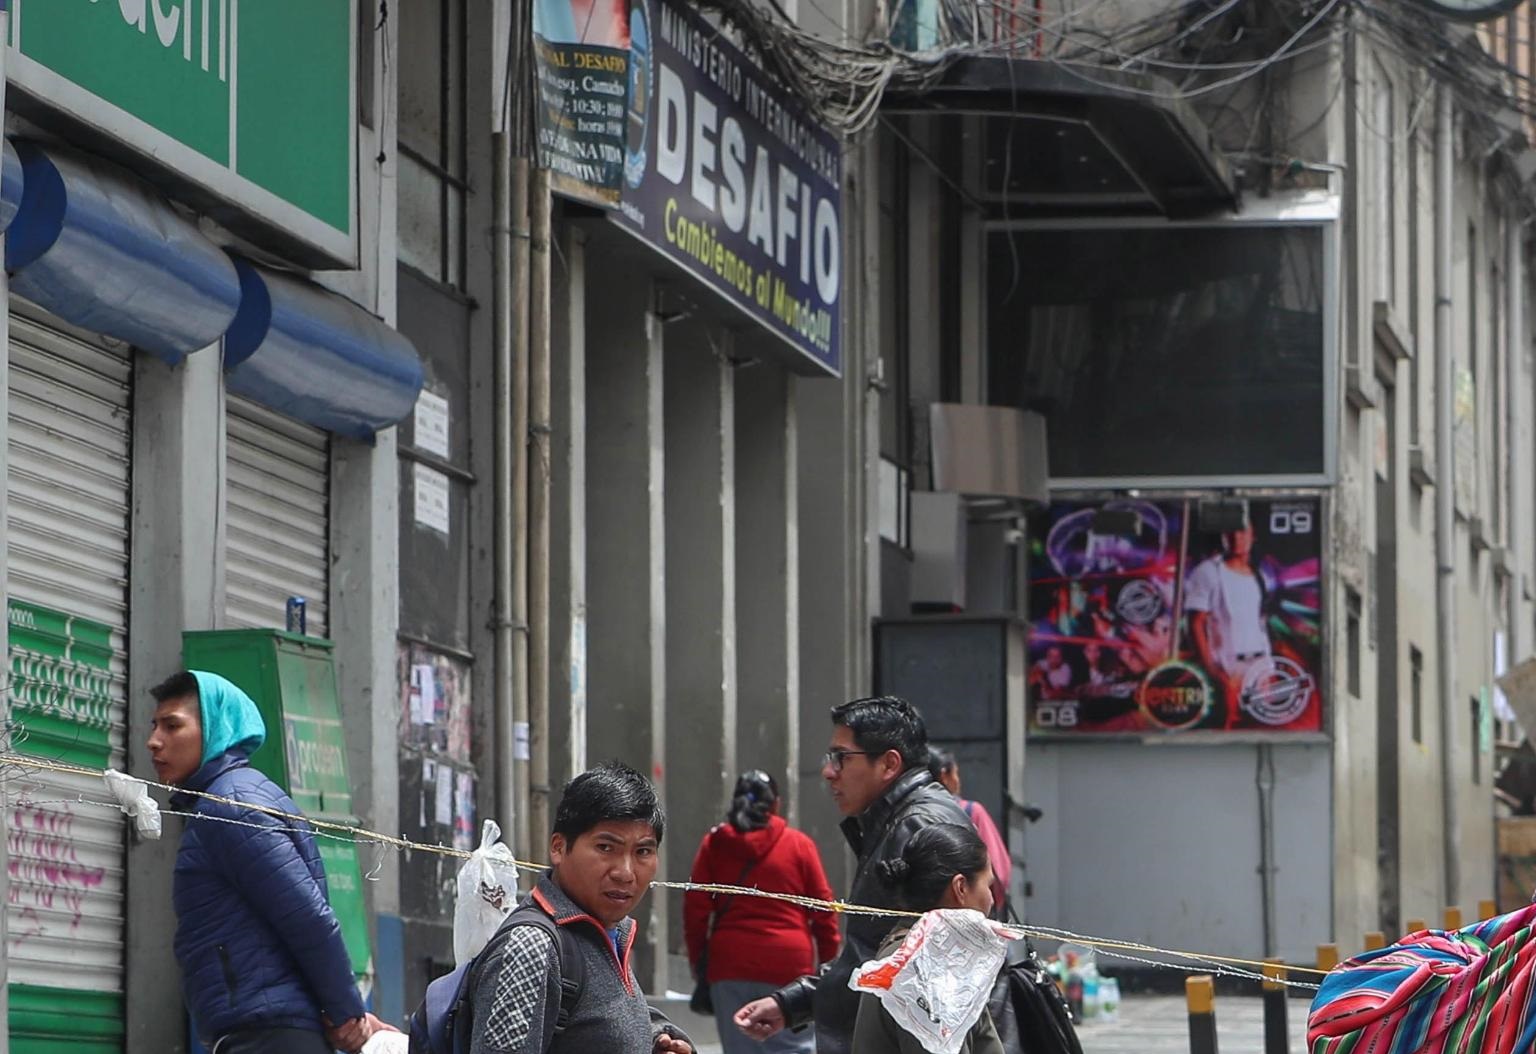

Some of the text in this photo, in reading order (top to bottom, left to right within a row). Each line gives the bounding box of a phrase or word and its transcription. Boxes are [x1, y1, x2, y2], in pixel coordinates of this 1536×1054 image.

[661, 2, 839, 190] MINISTERIO INTERNACIONAL
[657, 62, 839, 305] DESAFIO
[665, 197, 752, 297] Cambiemos
[756, 269, 771, 309] al
[1270, 511, 1312, 534] 09
[1036, 707, 1077, 728] 08
